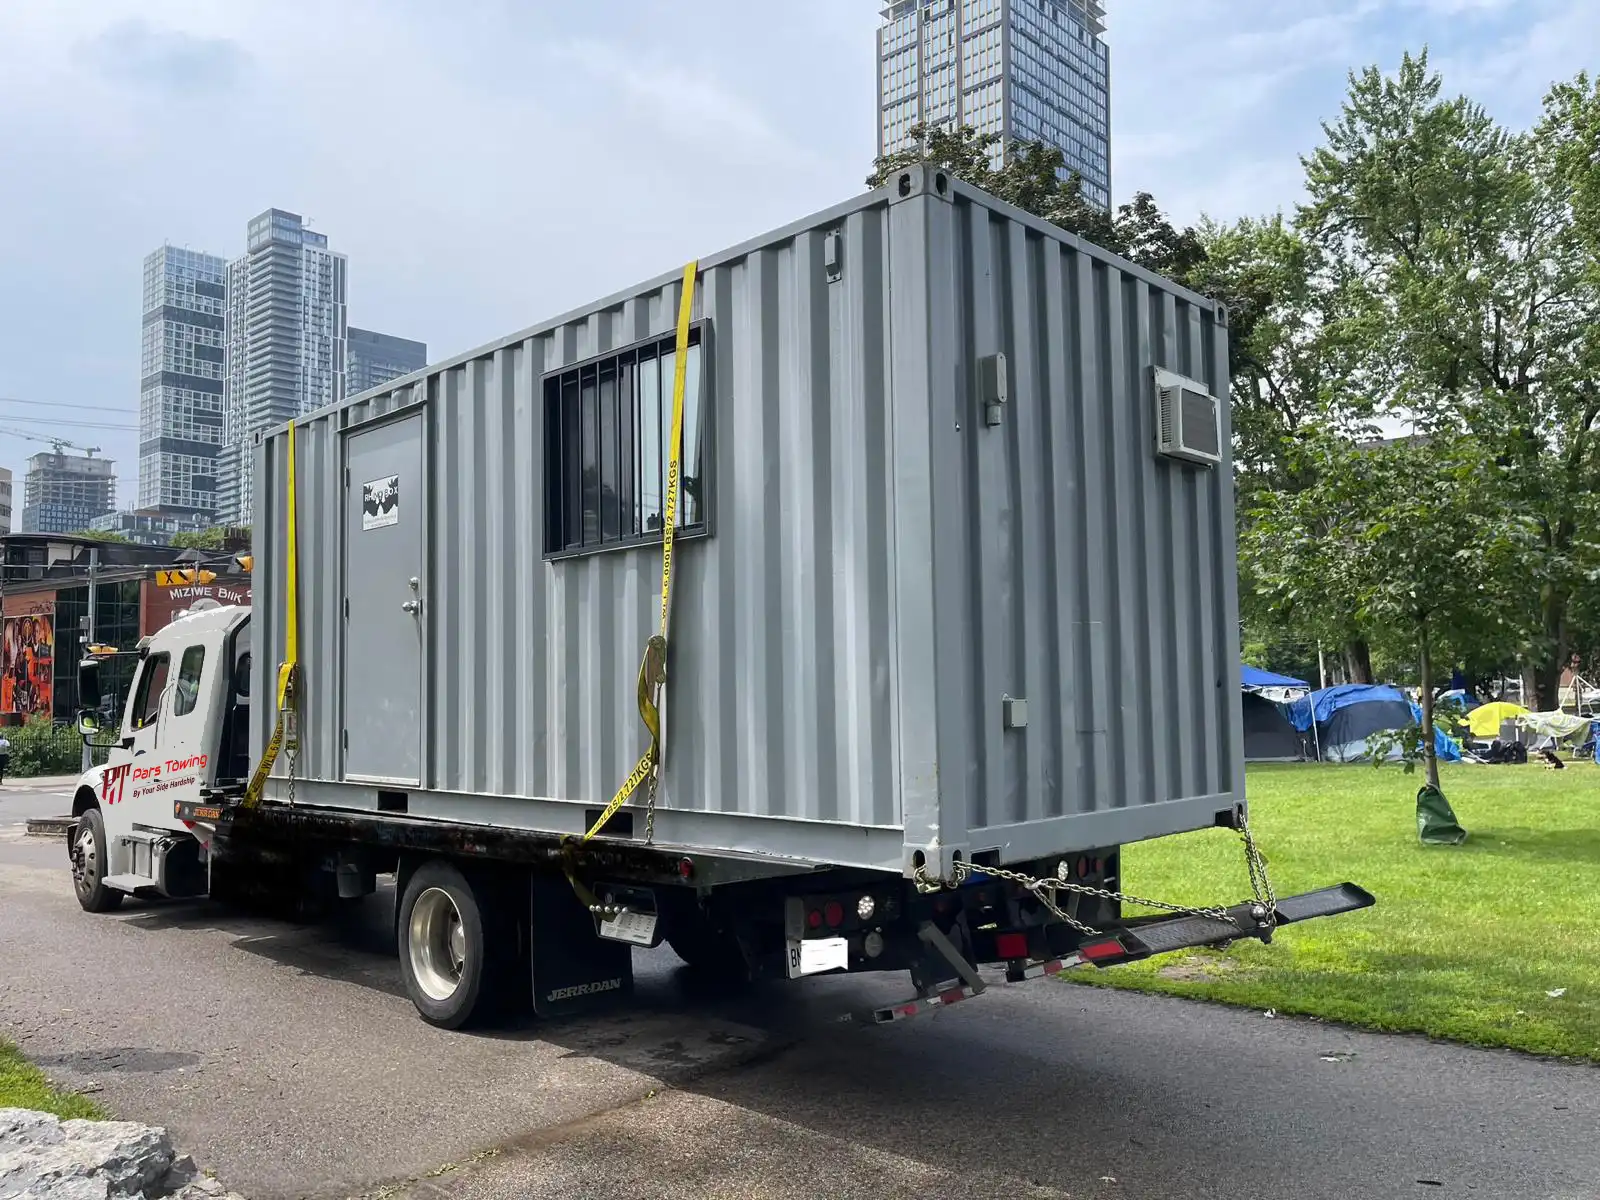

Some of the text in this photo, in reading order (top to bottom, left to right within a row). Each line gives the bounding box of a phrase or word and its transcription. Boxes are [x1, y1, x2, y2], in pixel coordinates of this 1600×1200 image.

[169, 587, 212, 600] MIZIWE
[132, 754, 208, 781] Pars Towing
[133, 776, 196, 798] By Your Side Hardship
